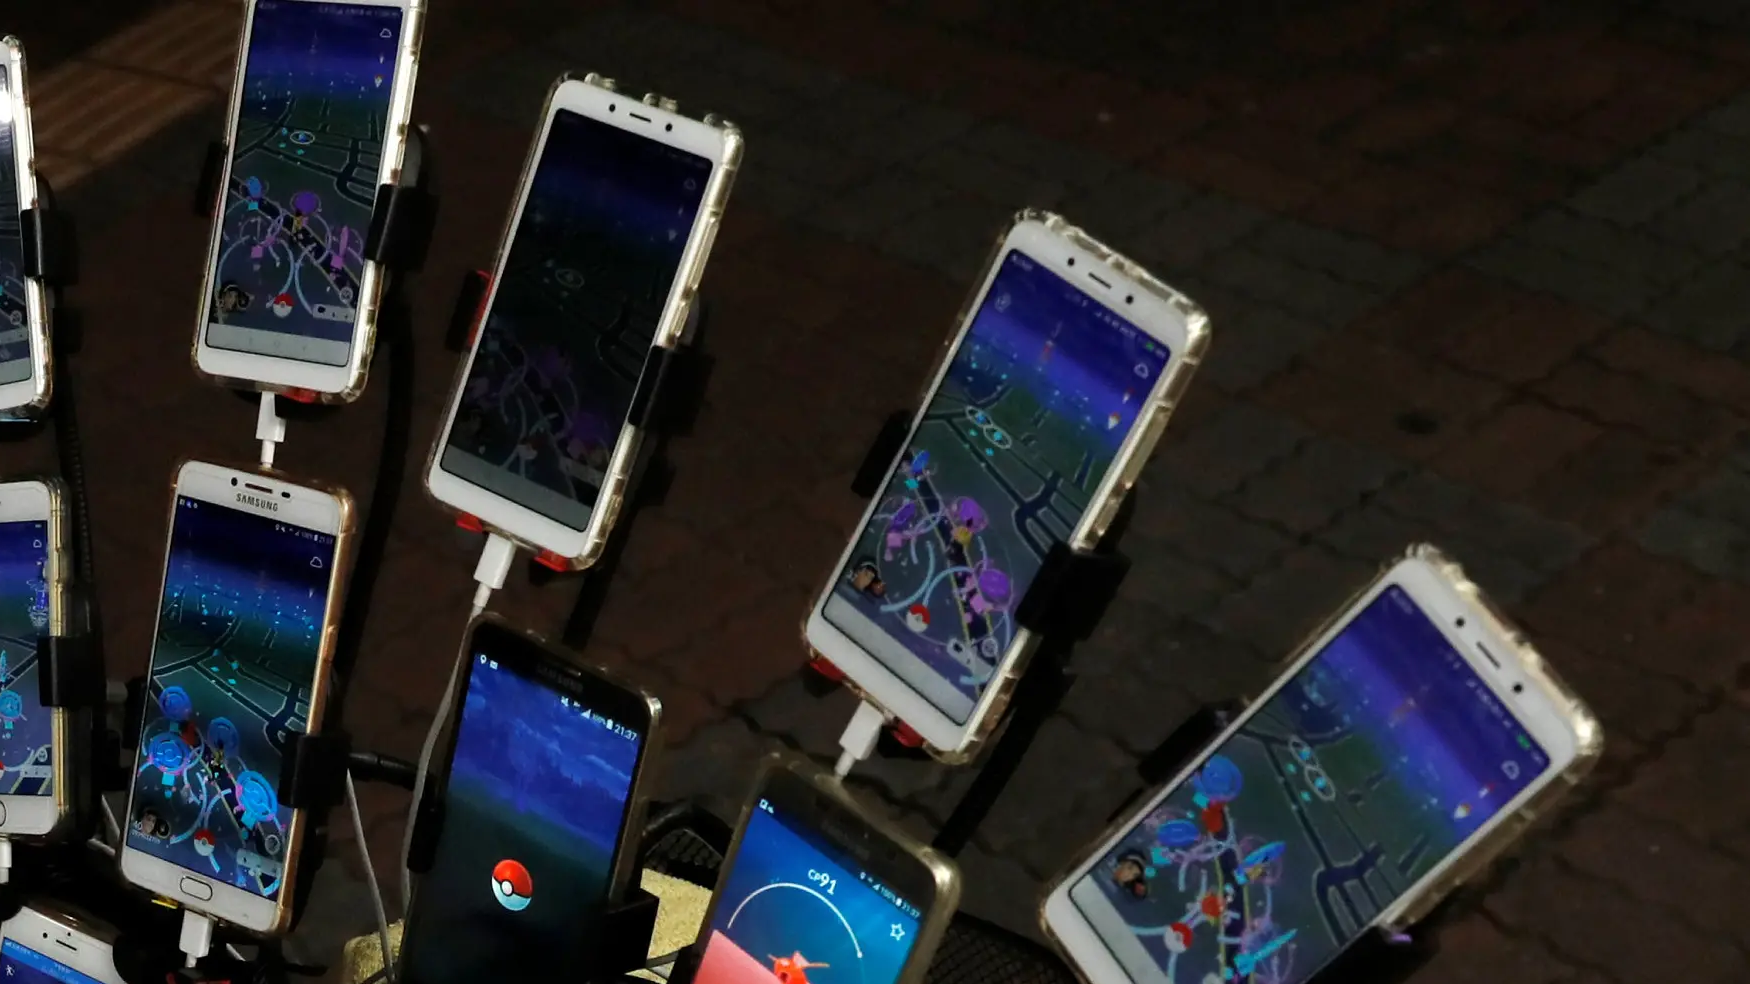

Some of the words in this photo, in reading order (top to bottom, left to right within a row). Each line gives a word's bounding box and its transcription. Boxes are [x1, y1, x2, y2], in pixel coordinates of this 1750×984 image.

[235, 493, 279, 512] SAMSUNG
[615, 724, 637, 741] 21:37
[901, 902, 921, 919] 21:37
